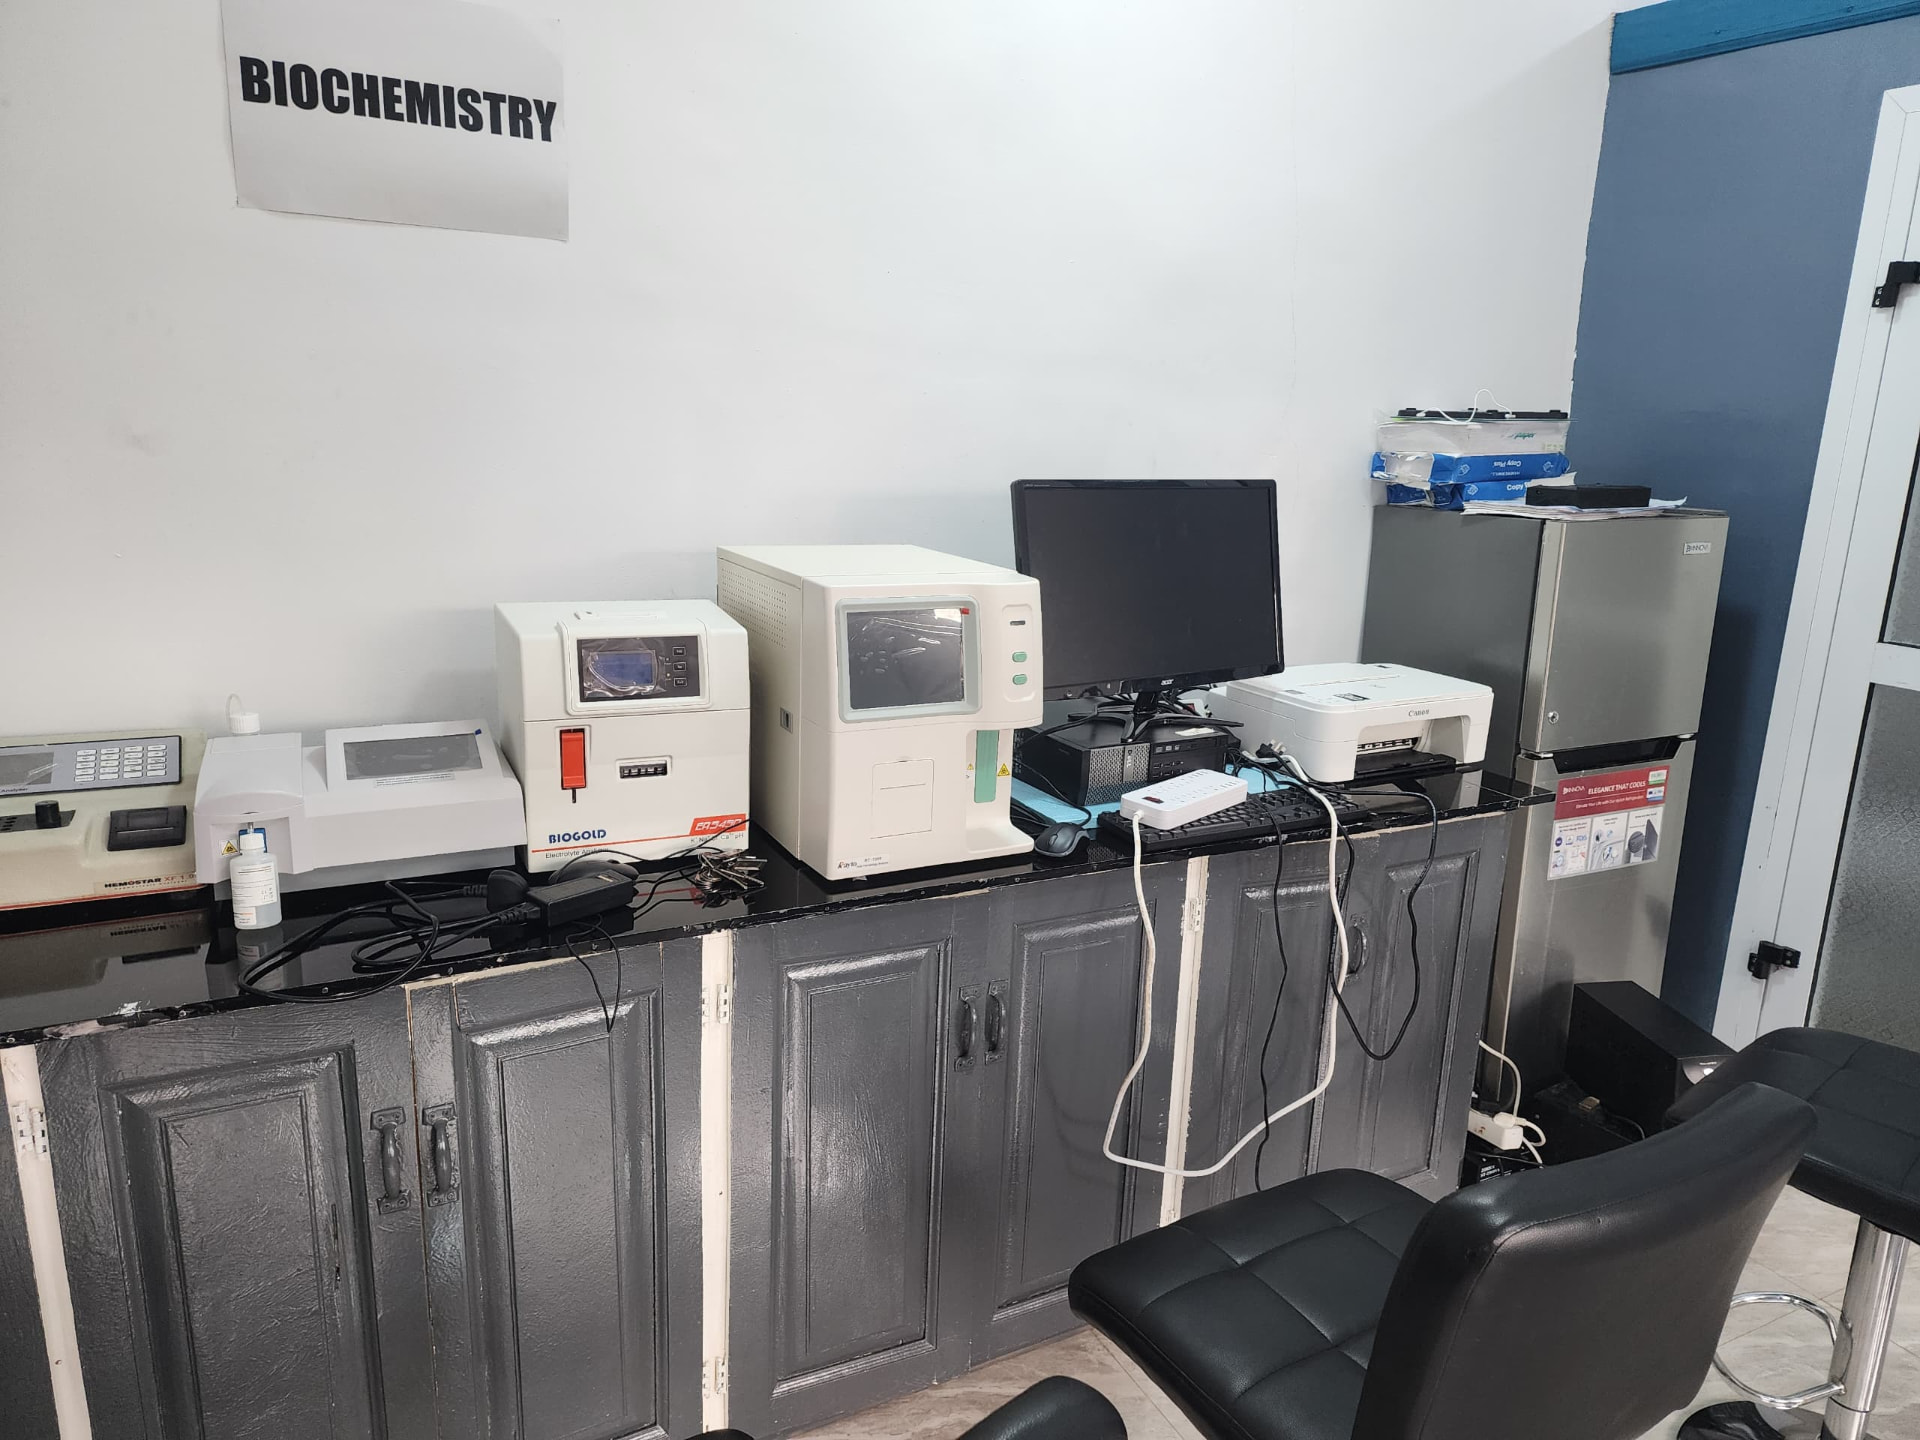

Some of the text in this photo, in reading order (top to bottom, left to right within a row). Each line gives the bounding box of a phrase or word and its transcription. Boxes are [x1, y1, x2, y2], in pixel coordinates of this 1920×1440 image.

[239, 56, 557, 142] BIOCHEMISTRY
[1506, 459, 1522, 467] Copy
[1408, 709, 1430, 717] Canon
[1588, 784, 1616, 795] ELEGANCE
[1615, 782, 1629, 792] THAT
[1629, 780, 1646, 789] COOLS
[548, 829, 607, 844] BIOGOLD
[545, 849, 580, 859] Electrolyte
[104, 877, 162, 888] HEMOSTAR
